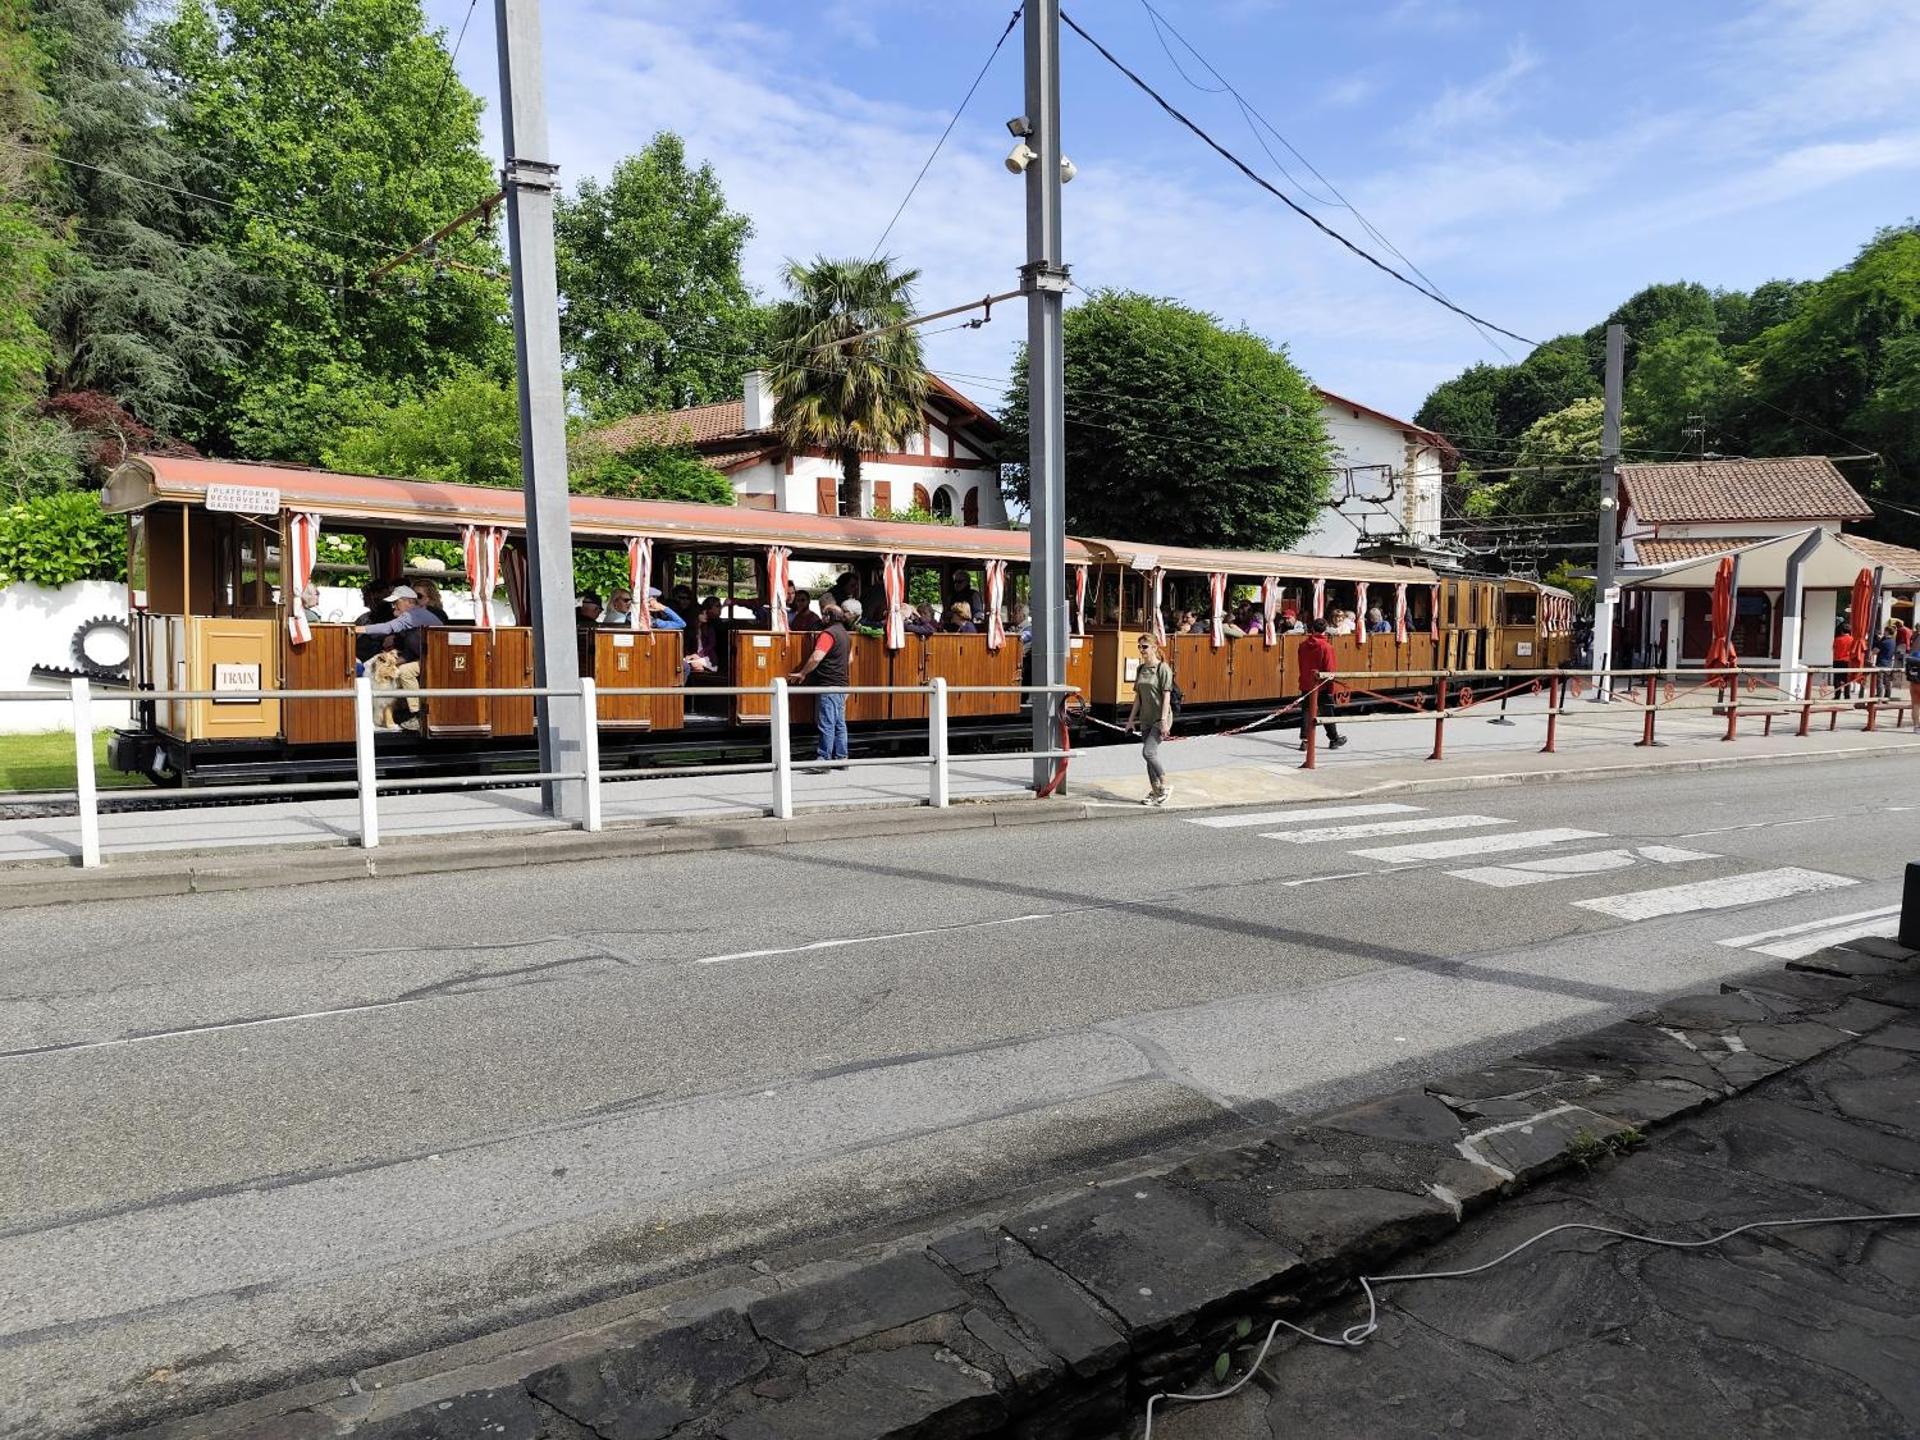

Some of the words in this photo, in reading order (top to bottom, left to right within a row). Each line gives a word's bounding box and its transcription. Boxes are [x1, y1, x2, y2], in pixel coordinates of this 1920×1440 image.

[455, 656, 465, 669] 12
[758, 655, 766, 666] 10
[221, 672, 255, 684] TRAIN
